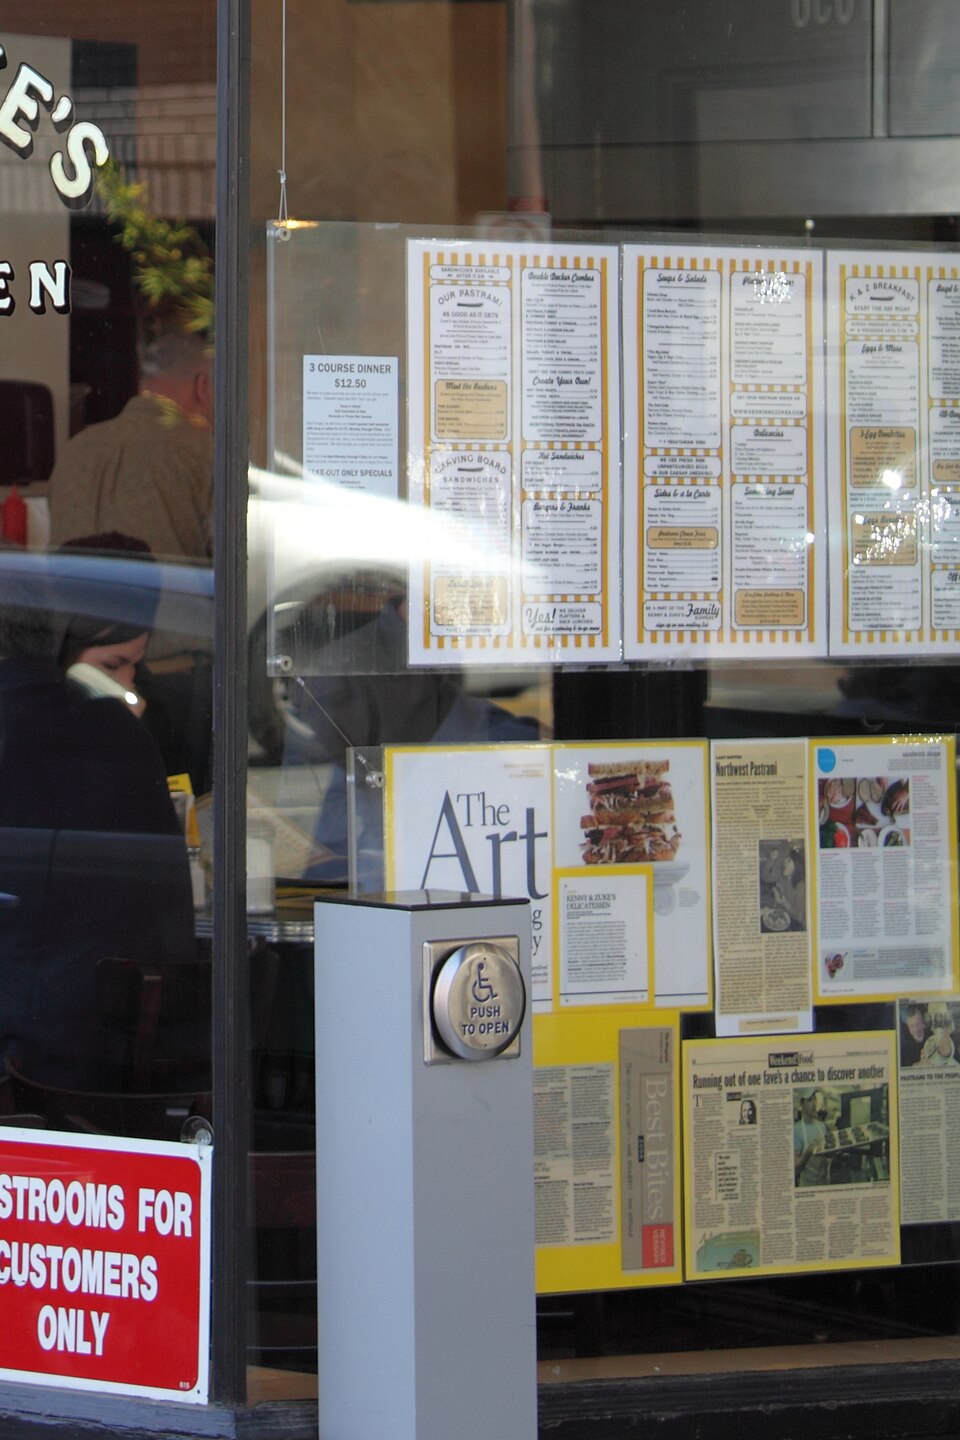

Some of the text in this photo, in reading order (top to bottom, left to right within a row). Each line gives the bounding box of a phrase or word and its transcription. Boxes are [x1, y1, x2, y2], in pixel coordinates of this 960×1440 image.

[657, 273, 675, 283] Soups
[685, 274, 707, 282] Salads
[438, 289, 502, 307] OUR PASTRAMI
[873, 282, 914, 301] BREAKFAST
[310, 363, 391, 374] 3 COURSE DINNER
[335, 378, 366, 388] $12.50
[342, 469, 359, 477] ONLY
[477, 455, 506, 474] BOARD
[525, 608, 556, 628] Yes!
[685, 603, 720, 618] Family
[716, 760, 777, 776] Northwest Pastrami
[456, 792, 510, 827] The
[420, 789, 549, 900] Art
[471, 1006, 500, 1018] PUSH
[462, 1022, 509, 1035] TO OPEN
[799, 1054, 813, 1064] Food
[693, 1074, 722, 1090] Running
[724, 1073, 736, 1087] out
[738, 1071, 746, 1086] of
[748, 1074, 761, 1085] one
[763, 1070, 783, 1084] fave's
[791, 1069, 815, 1083] chance
[818, 1068, 825, 1082] to
[827, 1067, 855, 1081] discover
[858, 1065, 884, 1079] another
[645, 1077, 670, 1220] Best Bites
[138, 1187, 193, 1237] FOR
[37, 1304, 110, 1356] ONLY
